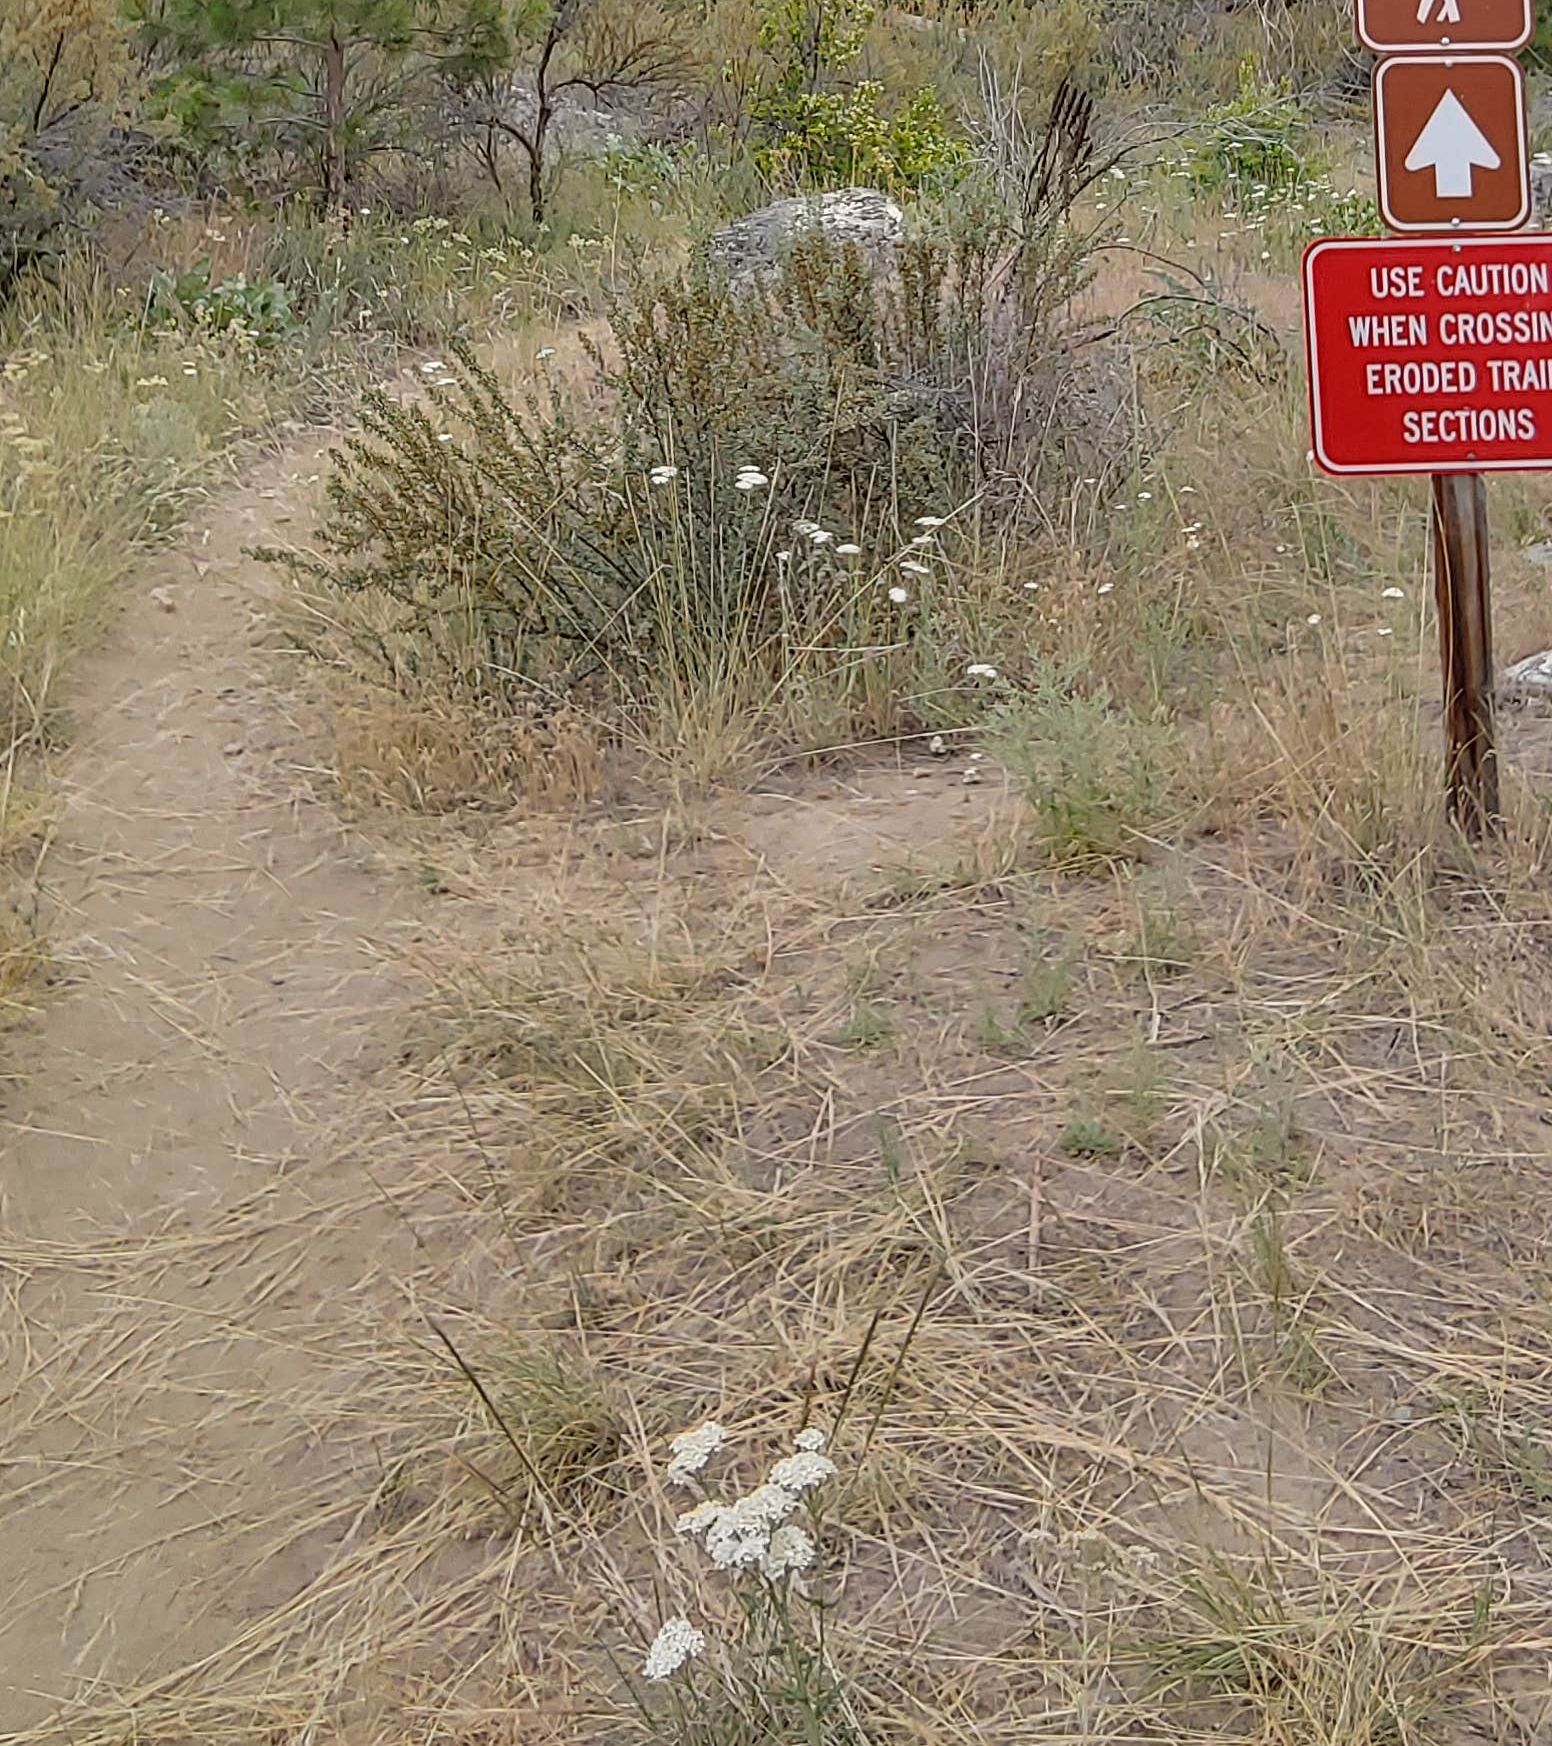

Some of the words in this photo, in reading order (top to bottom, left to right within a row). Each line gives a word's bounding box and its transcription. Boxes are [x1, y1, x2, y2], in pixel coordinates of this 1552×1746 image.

[1370, 266, 1425, 298] USE
[1436, 263, 1549, 296] CAUTION
[1348, 314, 1427, 347] WHEN
[1366, 361, 1476, 395] ERODED
[1403, 408, 1535, 443] SECTIONS
